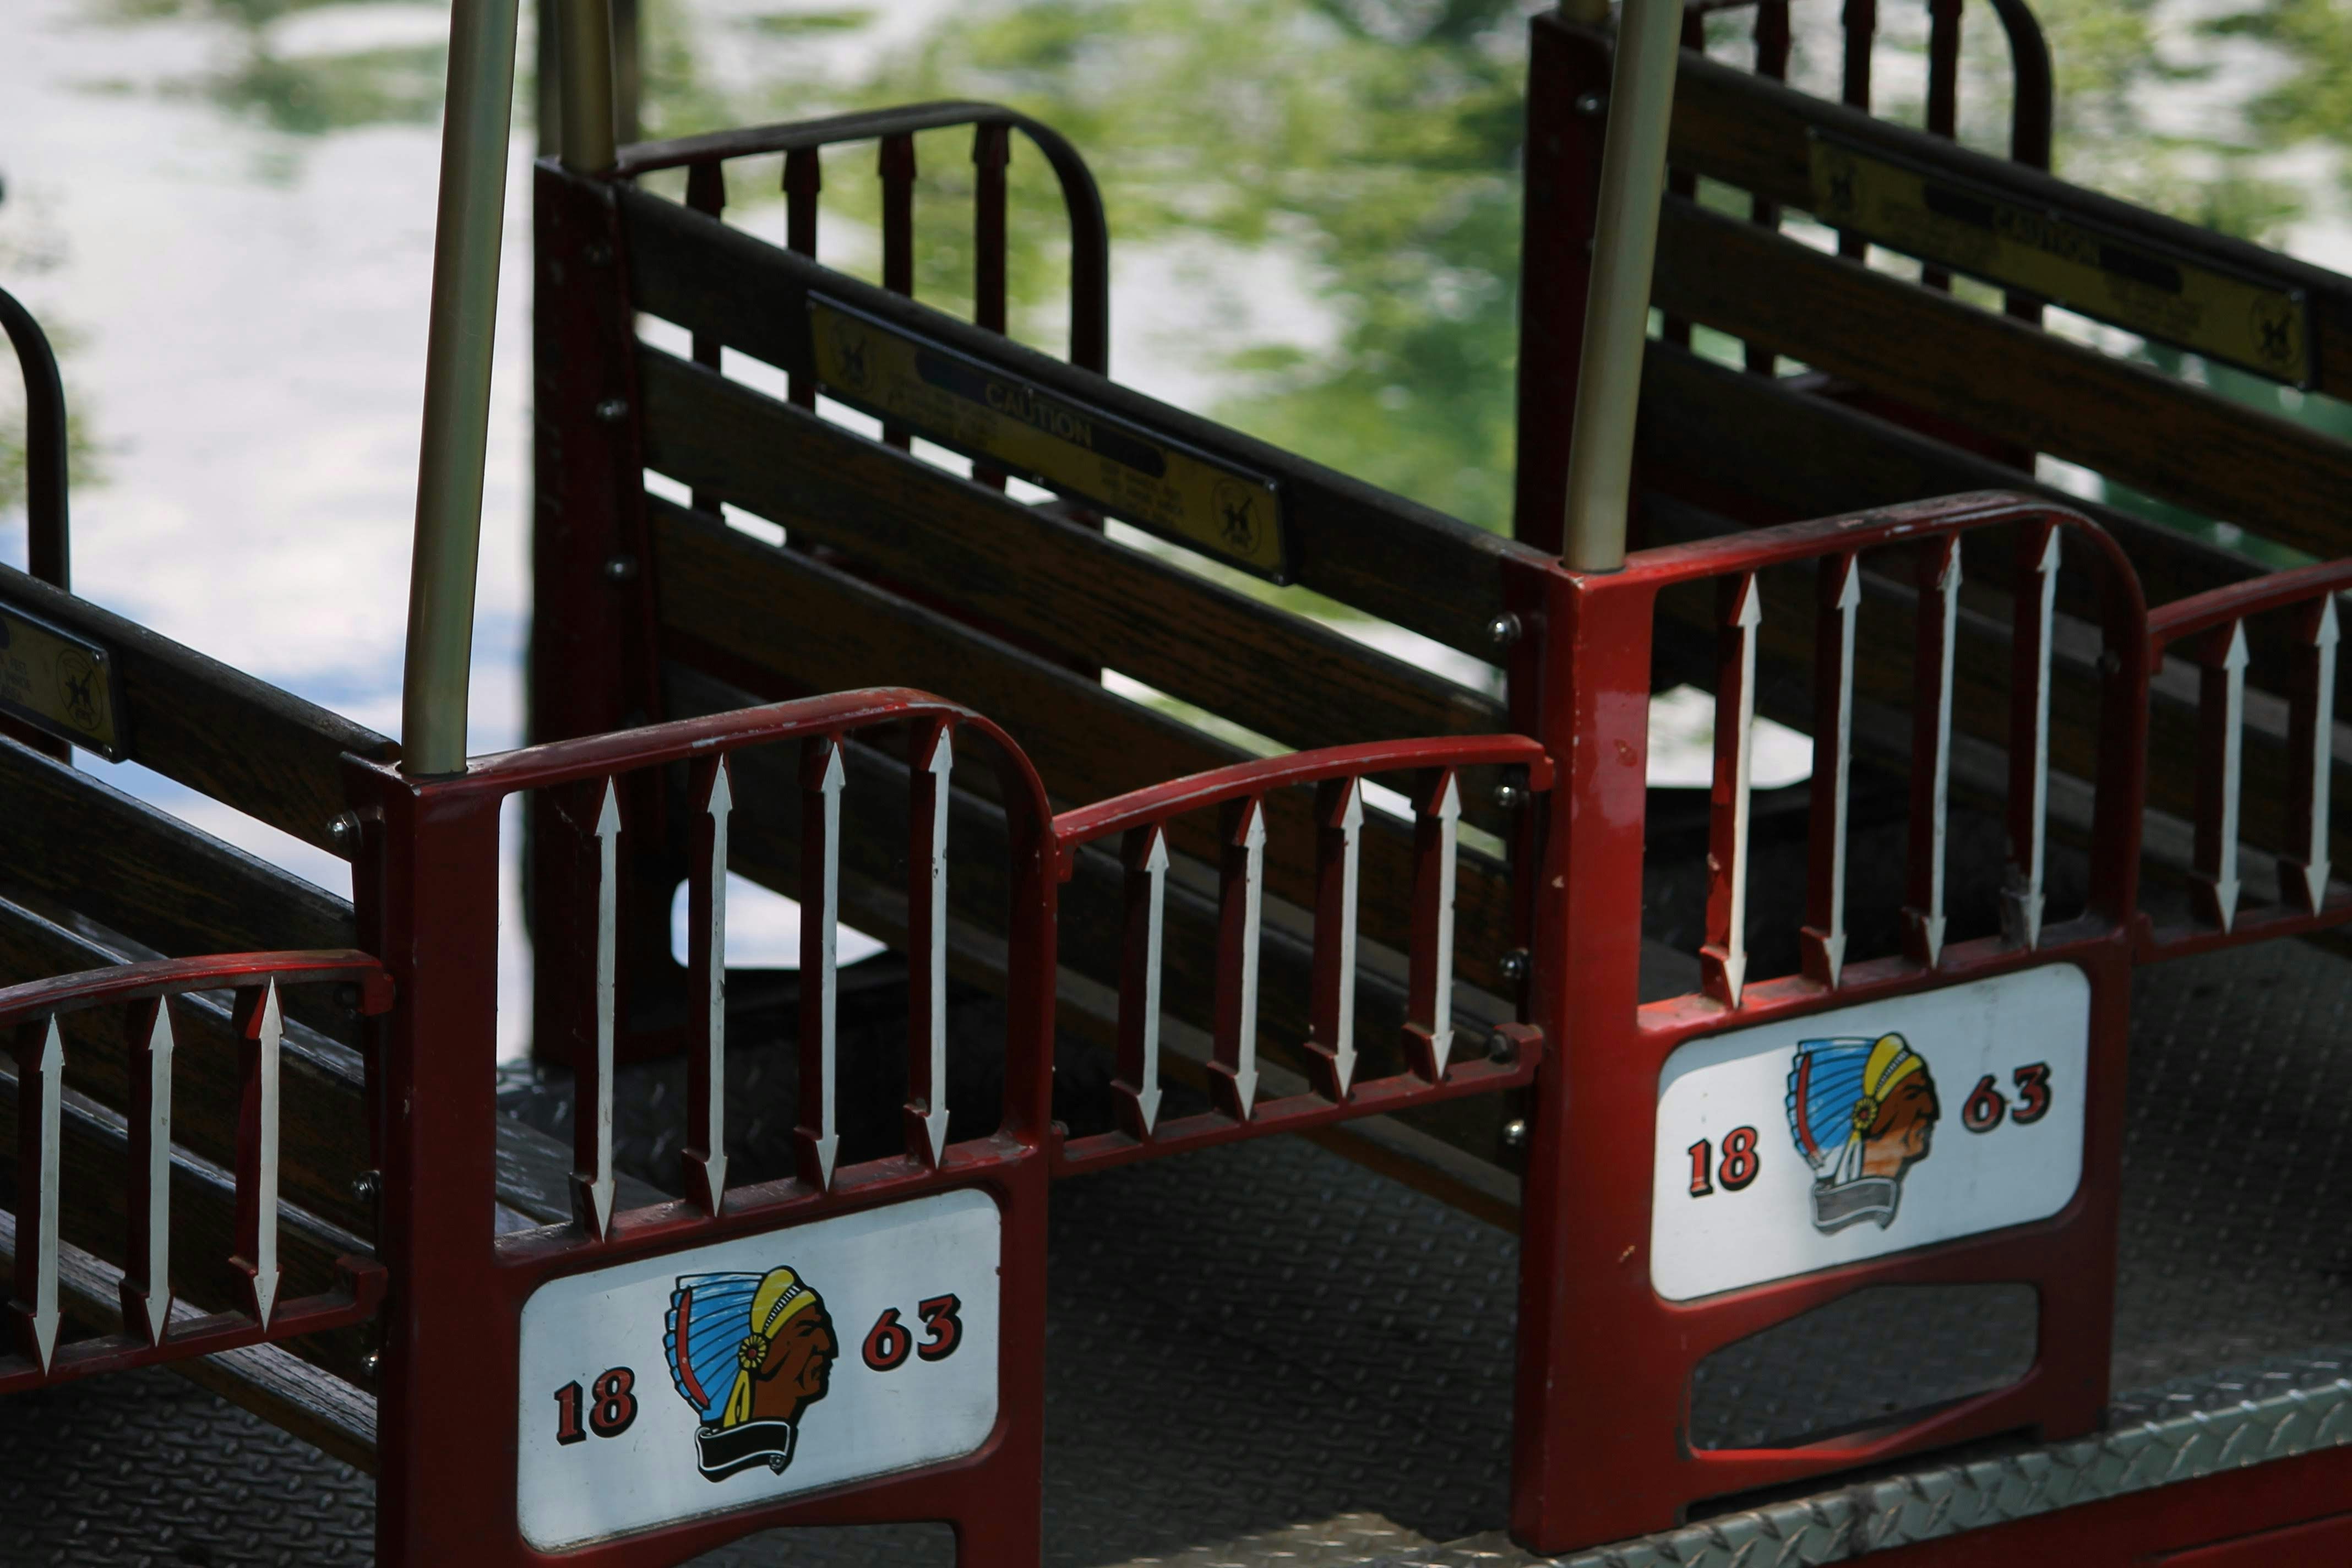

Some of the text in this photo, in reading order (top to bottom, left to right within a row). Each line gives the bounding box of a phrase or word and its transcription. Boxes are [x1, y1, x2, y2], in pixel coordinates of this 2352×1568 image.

[986, 382, 1093, 450] CAUTION
[1688, 1062, 2051, 1197] 18 63
[554, 1293, 962, 1446] 18 63
